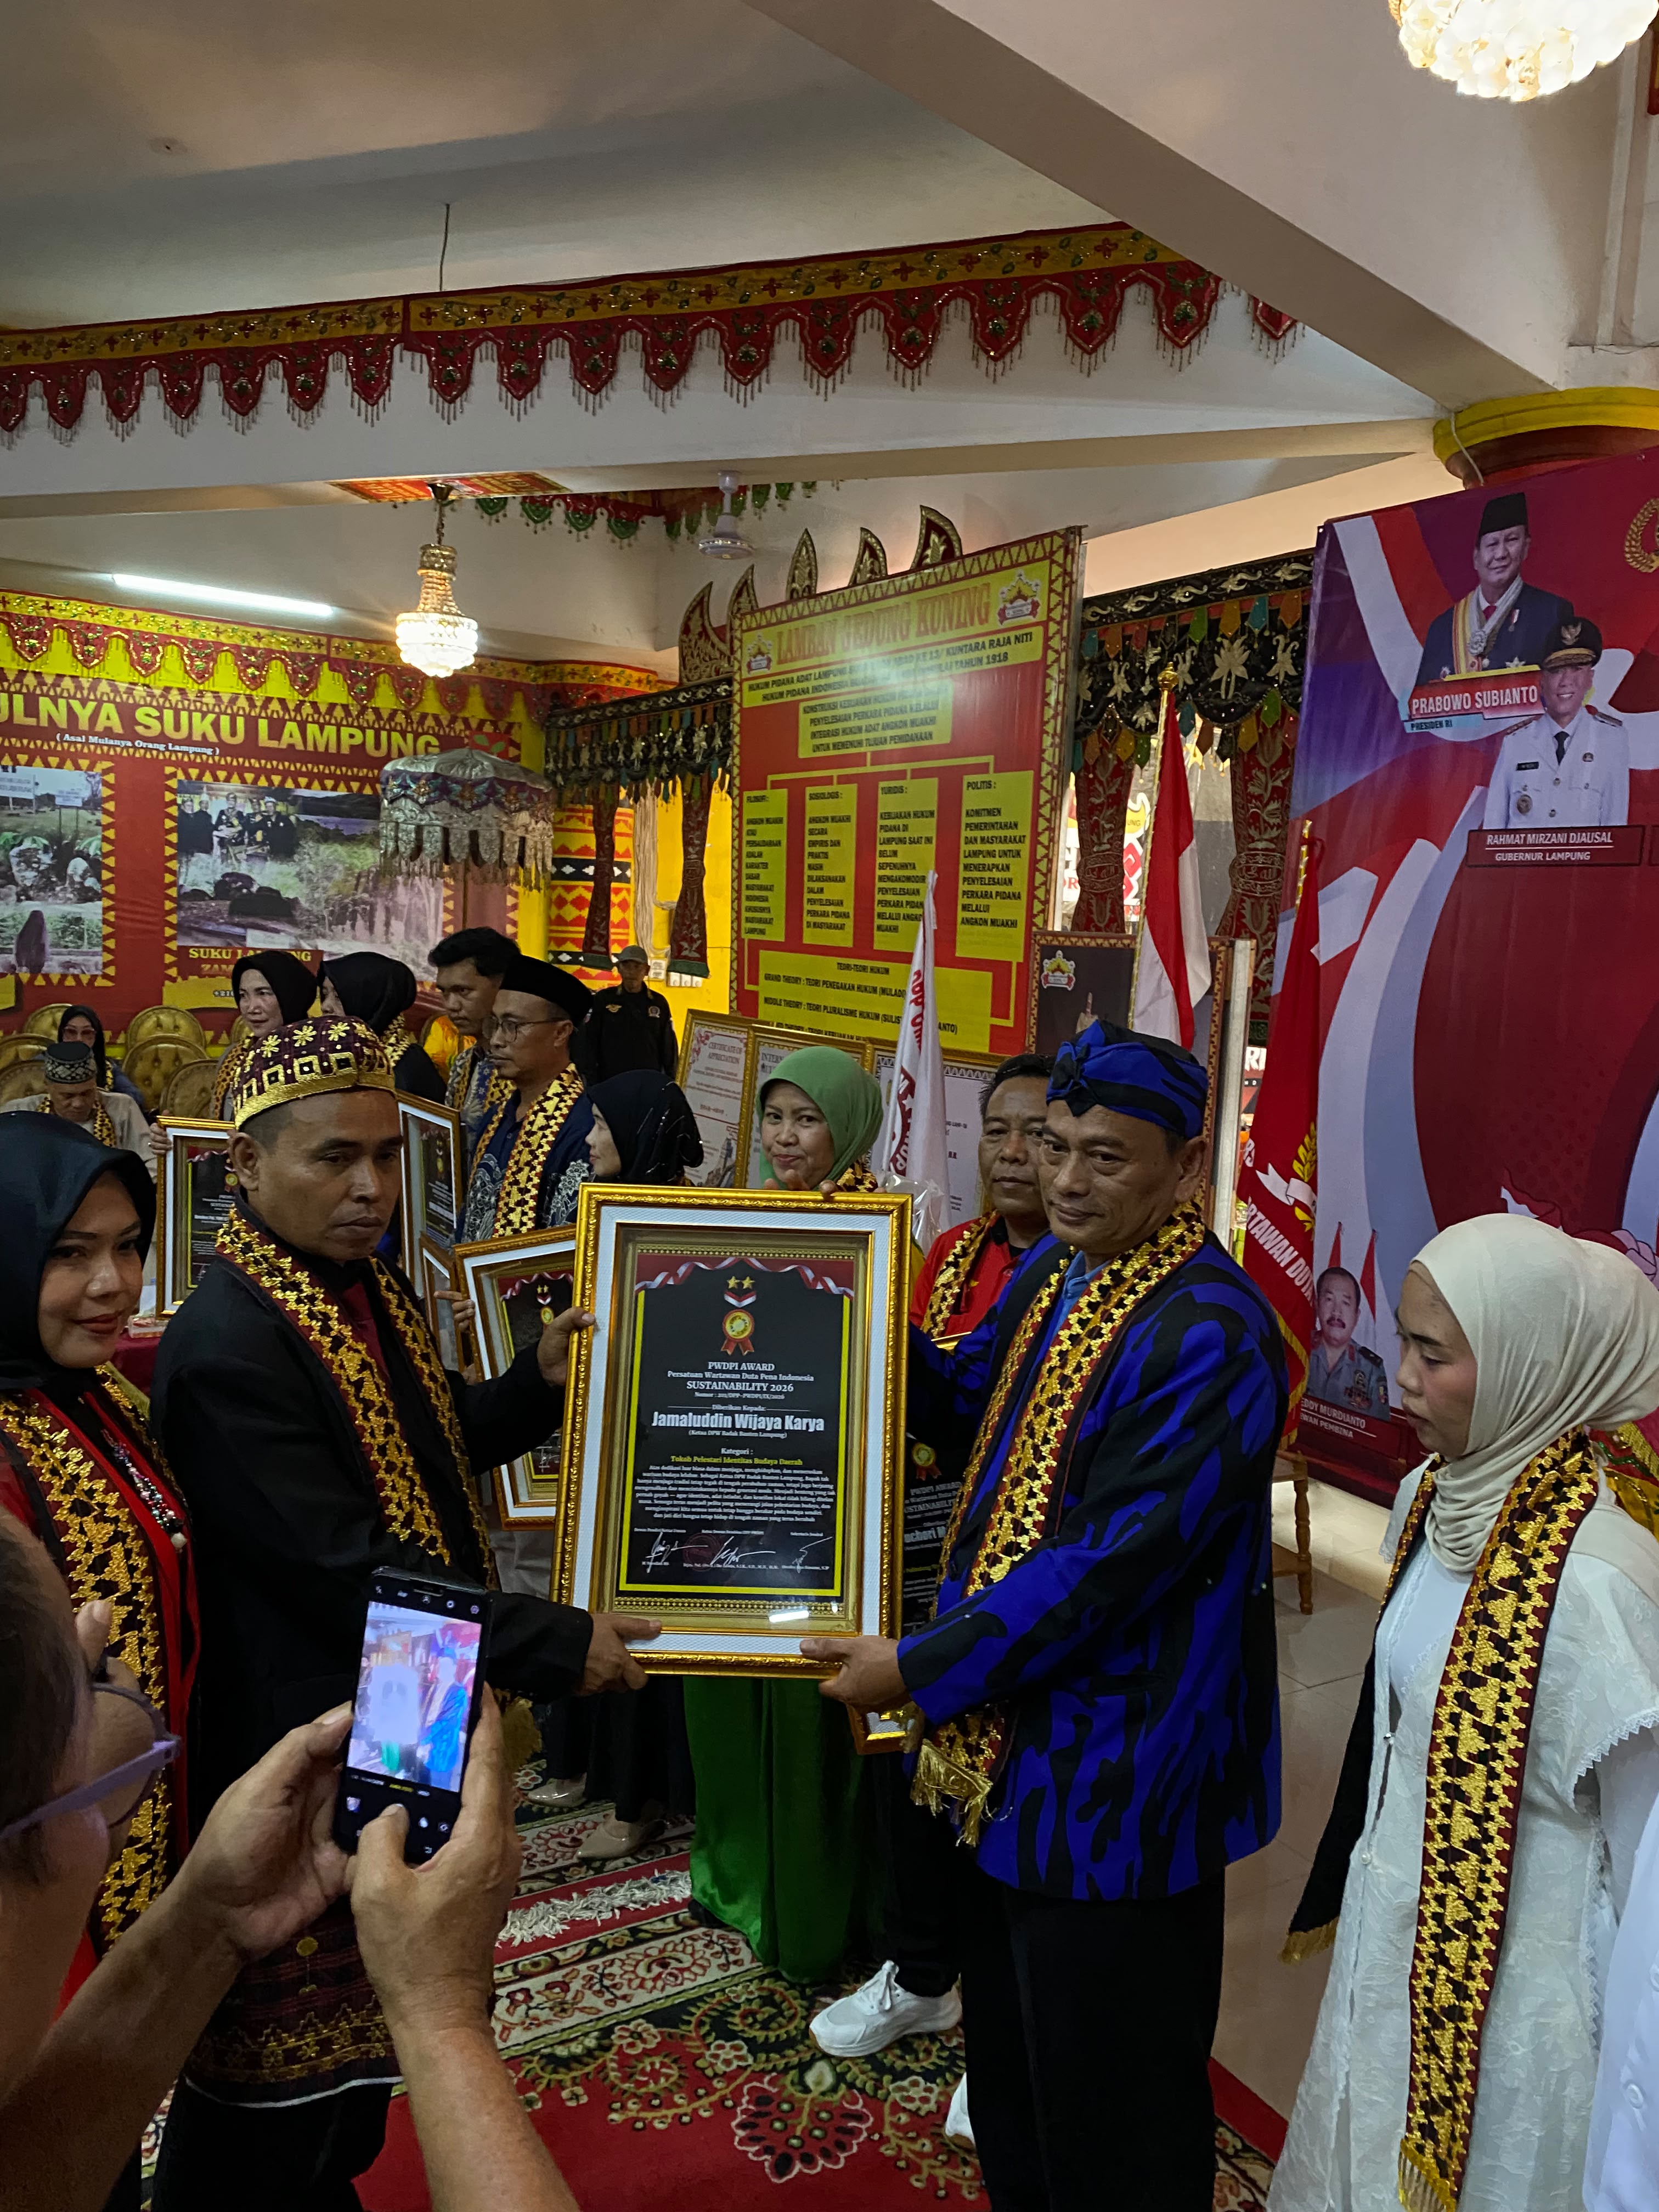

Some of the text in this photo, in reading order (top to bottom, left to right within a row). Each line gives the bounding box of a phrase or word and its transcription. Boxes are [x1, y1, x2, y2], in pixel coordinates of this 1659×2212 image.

[916, 583, 990, 637] KUNING
[771, 676, 794, 688] PIDANA
[796, 673, 812, 684] ADAT
[946, 641, 986, 657] KUNTARA
[989, 636, 1012, 650] RAJA
[1014, 631, 1032, 645] NITI
[762, 691, 785, 702] HUKUM
[786, 686, 810, 698] PIDANA
[955, 657, 983, 669] TAHUN
[986, 652, 1008, 665] 1918
[1412, 685, 1538, 714] PRABOWO SUBIANTO
[1411, 719, 1453, 731] PRESIDEN RI
[134, 706, 245, 745] SUKU
[258, 718, 439, 759] LAMPUNG
[63, 733, 214, 755] Asal Mulanya Orang Lampung
[967, 780, 992, 791] POLITIS
[966, 807, 1002, 818] KOMITMEN
[965, 821, 1018, 832] PEMERINTAHAN
[879, 836, 907, 845] LAMPUNG
[909, 836, 923, 845] SAAT
[964, 834, 1026, 845] DAN MASYARAKAT
[1487, 832, 1613, 845] RAHMAT MIRZANI DJAUSAL
[963, 849, 1022, 859] LAMPUNG UNTUK
[1496, 851, 1590, 861] GUBERNUR LAMPUNG
[963, 862, 1011, 873] MENERAPKAN
[962, 876, 1013, 887] PENYELESAIAN
[877, 887, 920, 896] PENYELESAIAN
[962, 889, 1022, 901] PERKARA PIDANA
[877, 899, 924, 909] PERKARA PIDAN
[961, 903, 990, 913] MELALUI
[902, 912, 922, 922] ANGKO
[961, 916, 1018, 928] ANGKON MUAKHI
[189, 947, 312, 962] SUKU LANG
[881, 1013, 902, 1025] (SULIS
[938, 1023, 957, 1035] ANTO)
[708, 1041, 736, 1054] CERTIFICATE
[708, 1052, 740, 1065] APPRECIATION
[1246, 1194, 1299, 1268] RTAWAN
[708, 1361, 775, 1371] PWDPI AWARD
[668, 1370, 703, 1379] Persatuan
[704, 1372, 741, 1380] Wartawan
[686, 1381, 794, 1392] SUSTAINABILITY 2026
[651, 1411, 825, 1432] Jamaluddin Wijaya Karya
[1319, 1404, 1366, 1429] MURDIANTO
